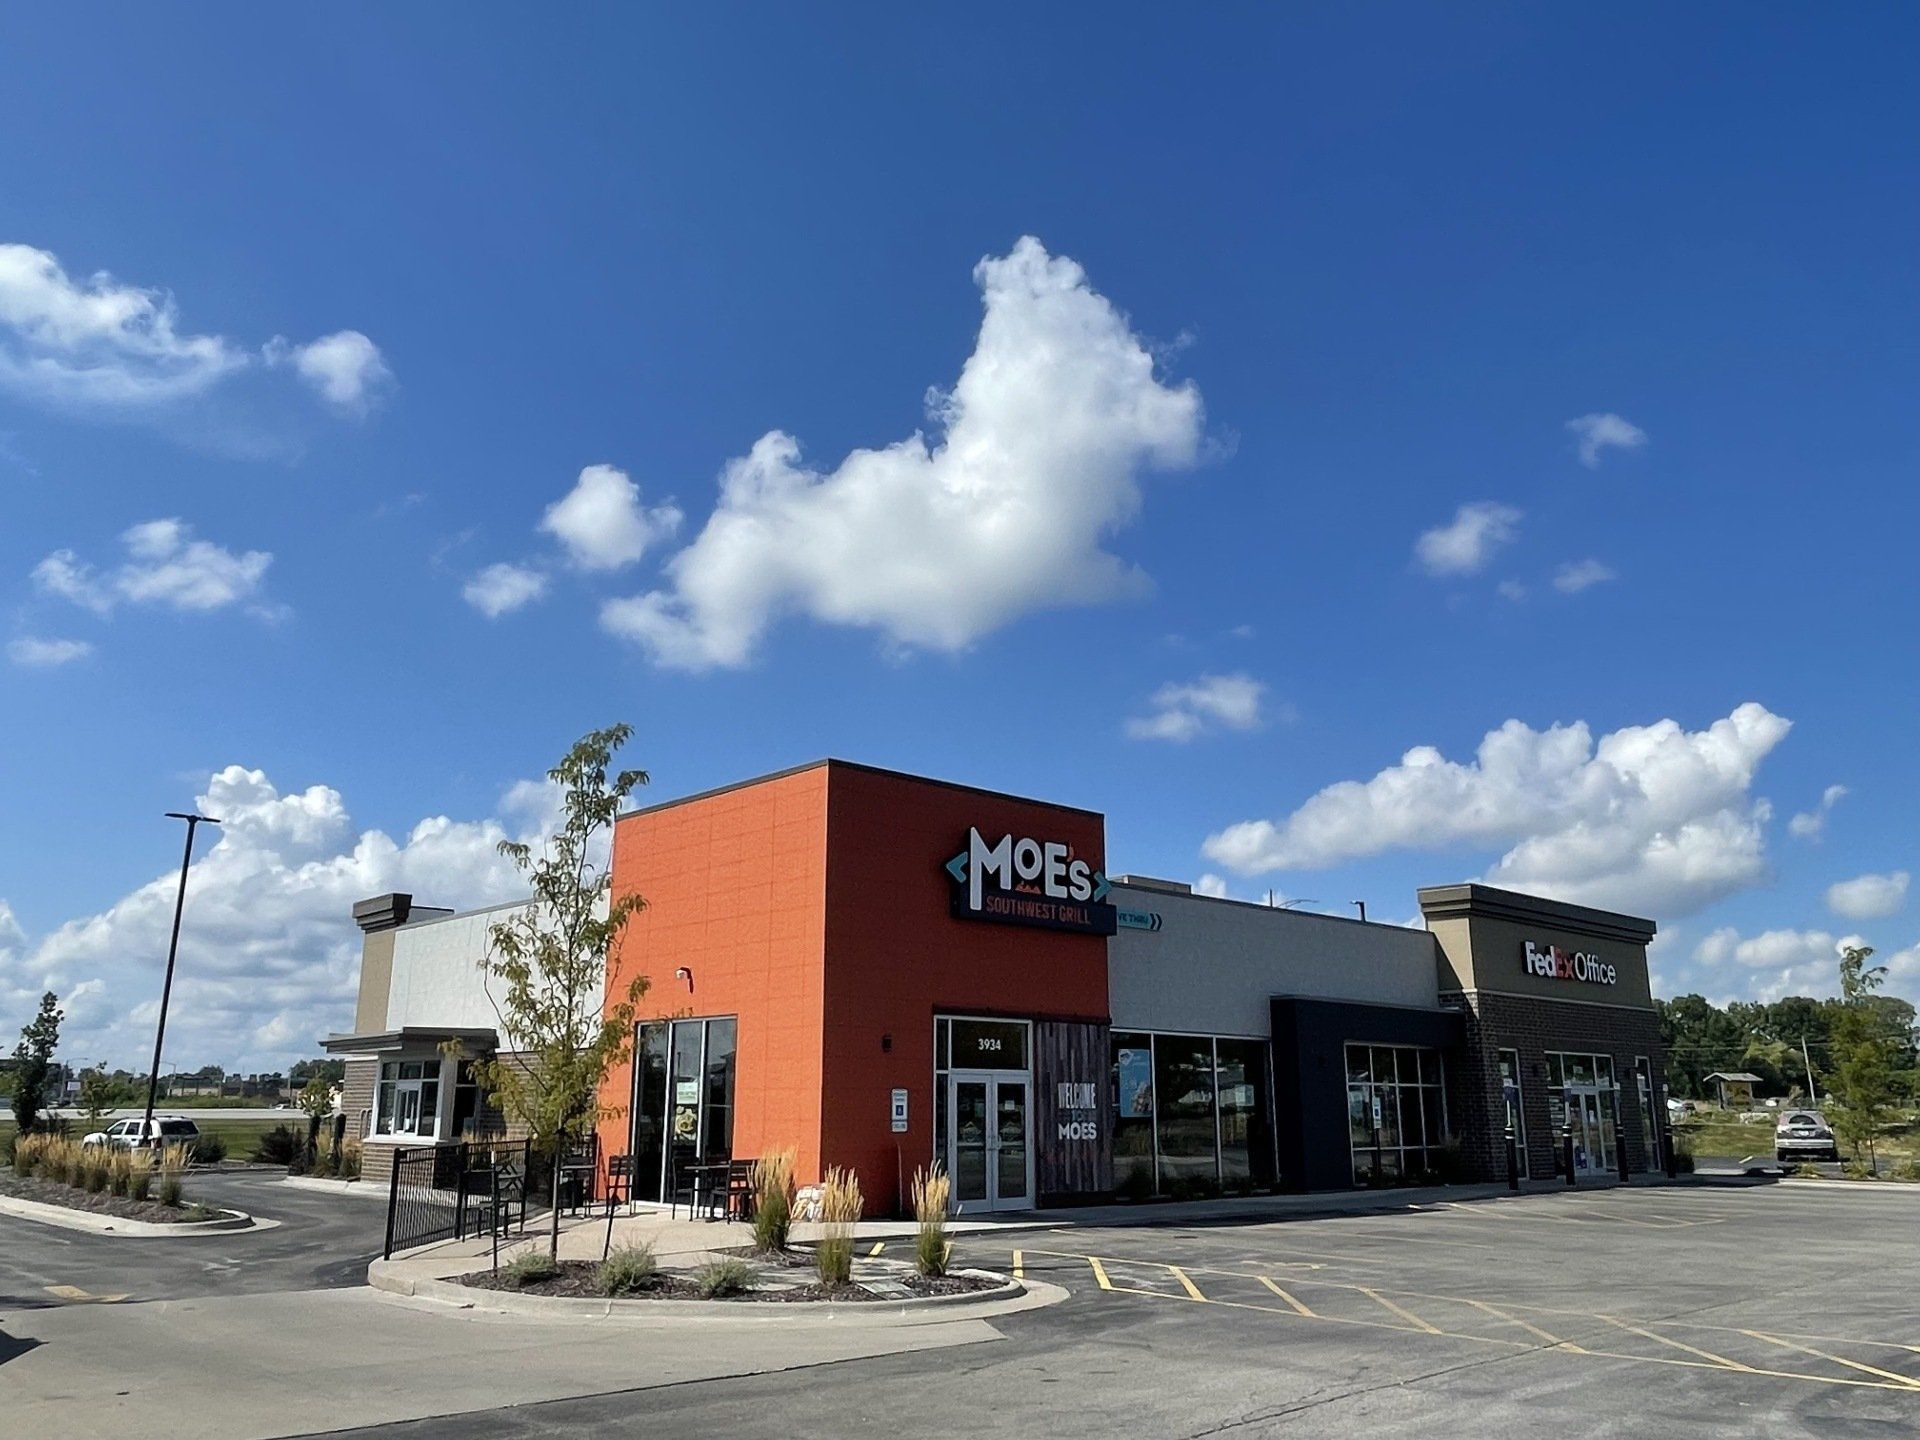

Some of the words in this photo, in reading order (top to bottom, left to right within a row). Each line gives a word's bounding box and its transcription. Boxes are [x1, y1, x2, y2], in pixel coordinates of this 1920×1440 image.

[986, 895, 1056, 919] SOUTHWEST
[1058, 904, 1091, 925] GRILL
[1525, 941, 1574, 979] FedEx
[1574, 952, 1617, 985] Office
[978, 1038, 1002, 1051] 3934
[1057, 1082, 1096, 1109] WELCOME
[1058, 1121, 1097, 1140] MOES
